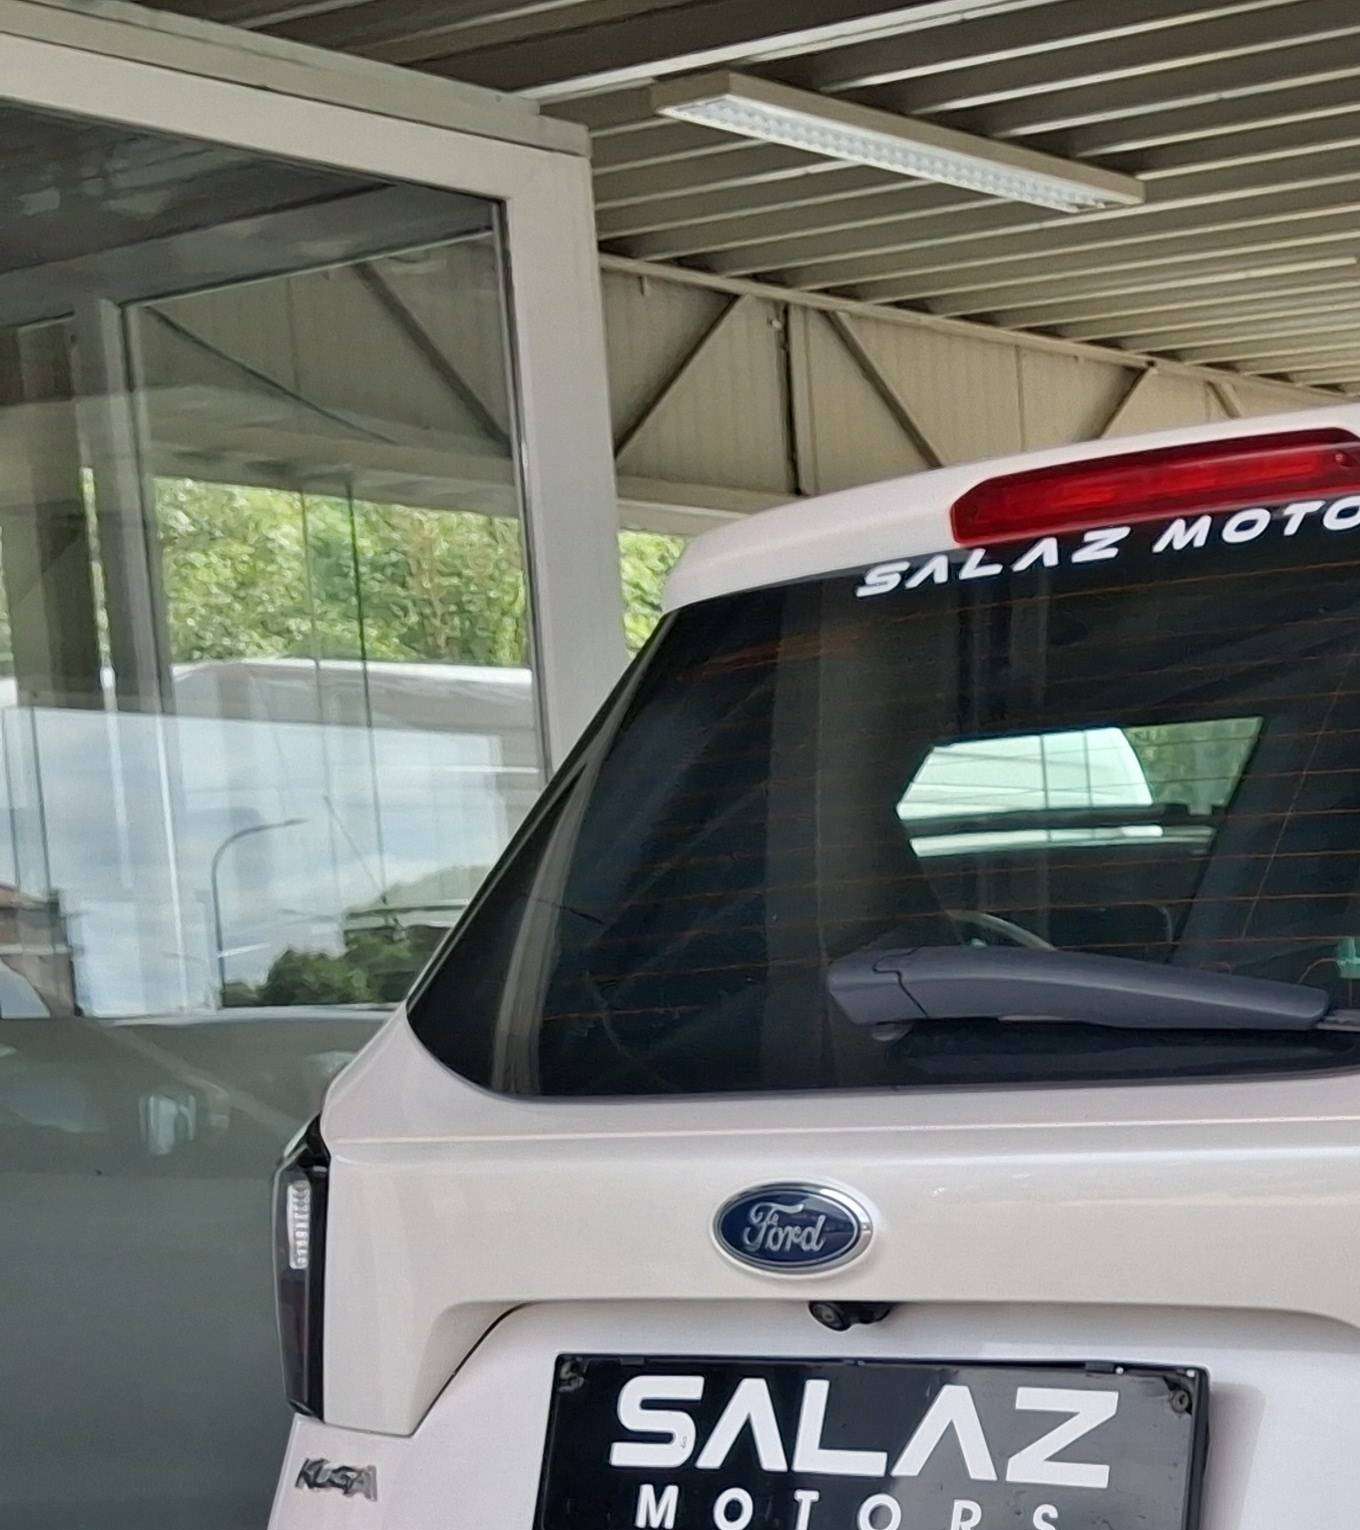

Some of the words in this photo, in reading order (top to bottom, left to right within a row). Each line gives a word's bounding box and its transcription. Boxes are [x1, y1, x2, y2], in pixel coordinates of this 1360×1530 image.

[855, 527, 1131, 598] SALAZ
[743, 1202, 826, 1251] Ford
[609, 1375, 1119, 1488] SALAZ
